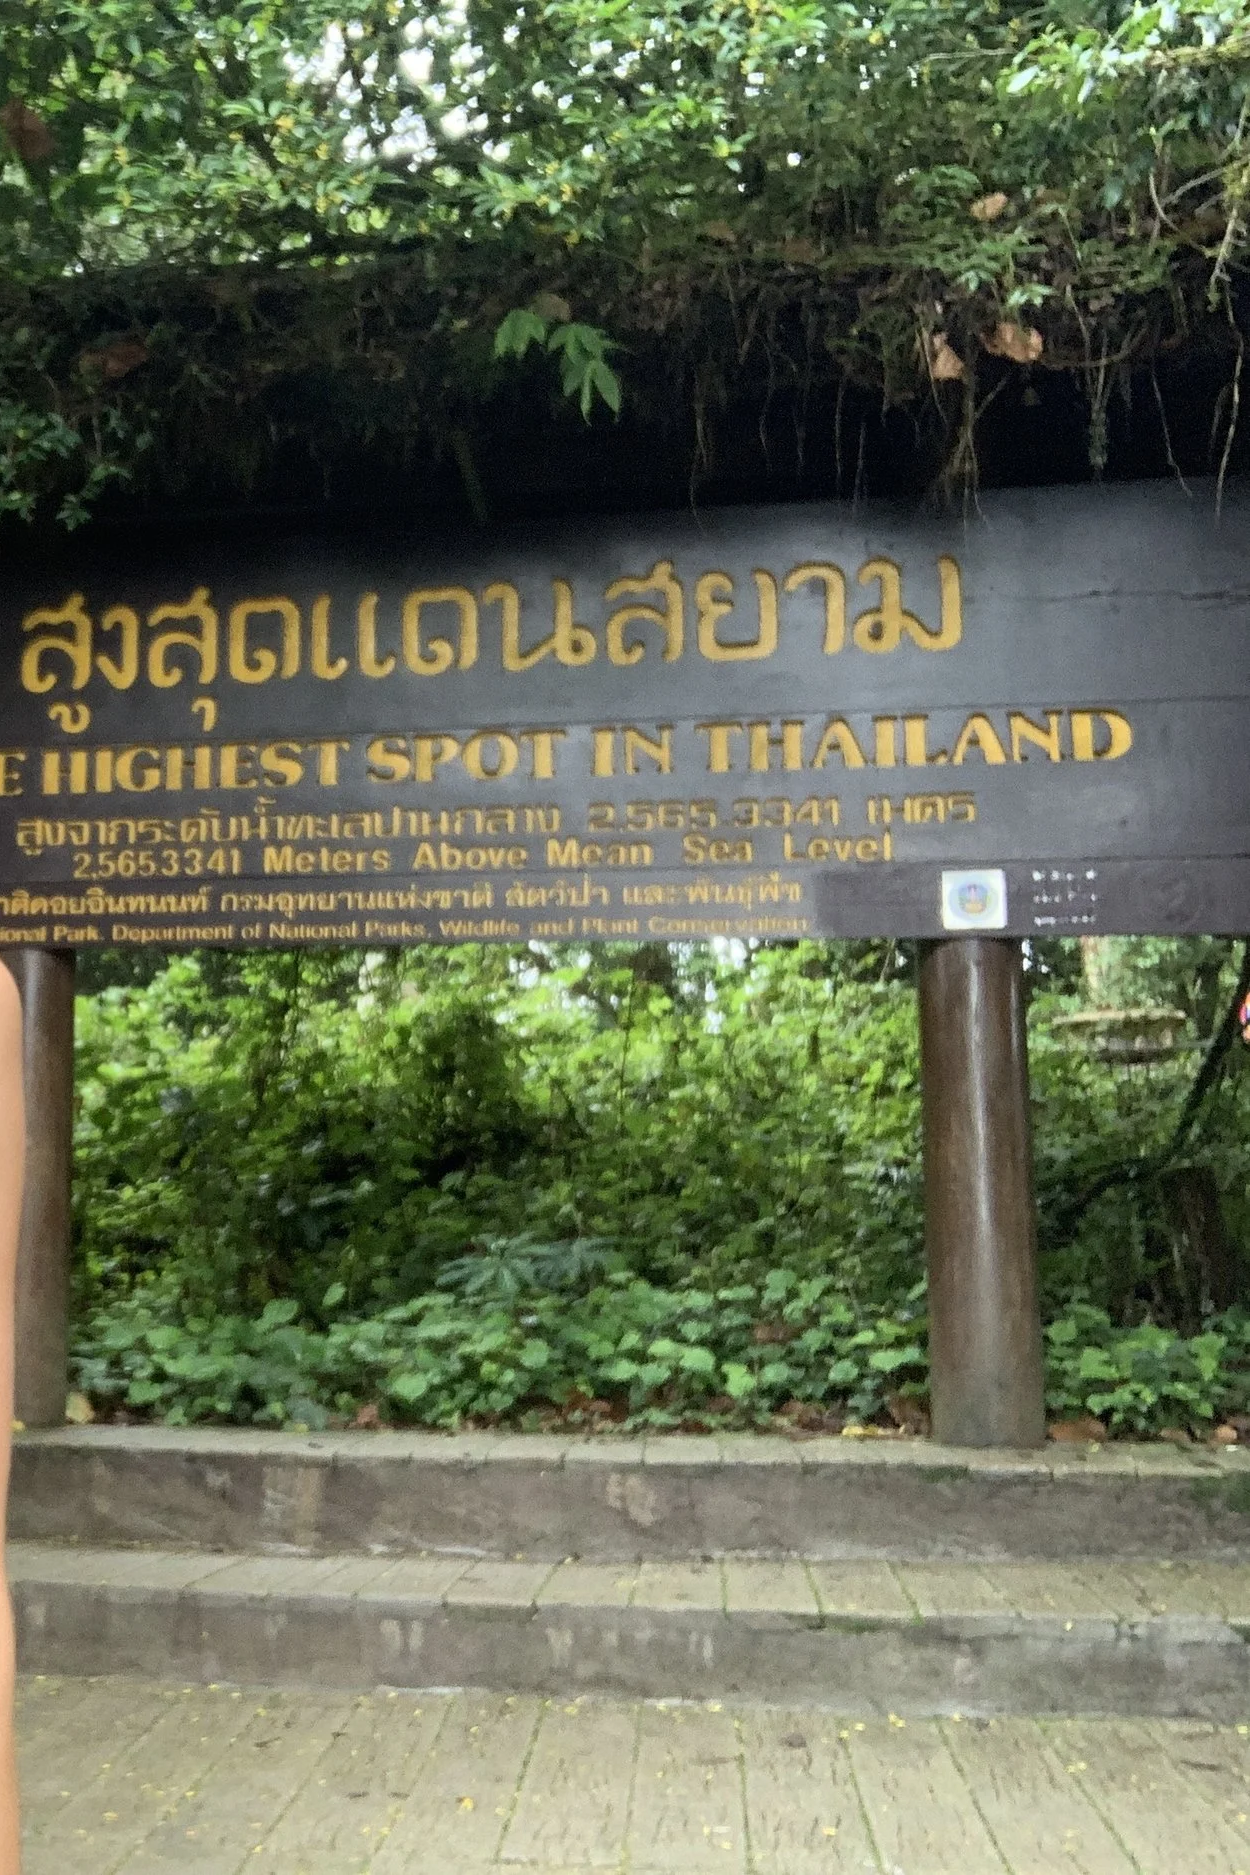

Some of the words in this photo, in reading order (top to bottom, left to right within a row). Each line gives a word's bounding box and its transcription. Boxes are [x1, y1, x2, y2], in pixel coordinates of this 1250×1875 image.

[19, 555, 963, 733] สูงสุดแดนสยาม
[41, 741, 350, 794] HIGHEST
[366, 731, 566, 784] SPOT
[591, 723, 675, 778] IN
[694, 709, 1133, 774] THAILAND
[263, 844, 391, 874] Meters
[412, 840, 529, 872] Above
[546, 836, 653, 868] Mean
[682, 831, 754, 865] Sea
[782, 826, 893, 863] Level
[241, 922, 260, 940] of
[269, 920, 359, 940] National
